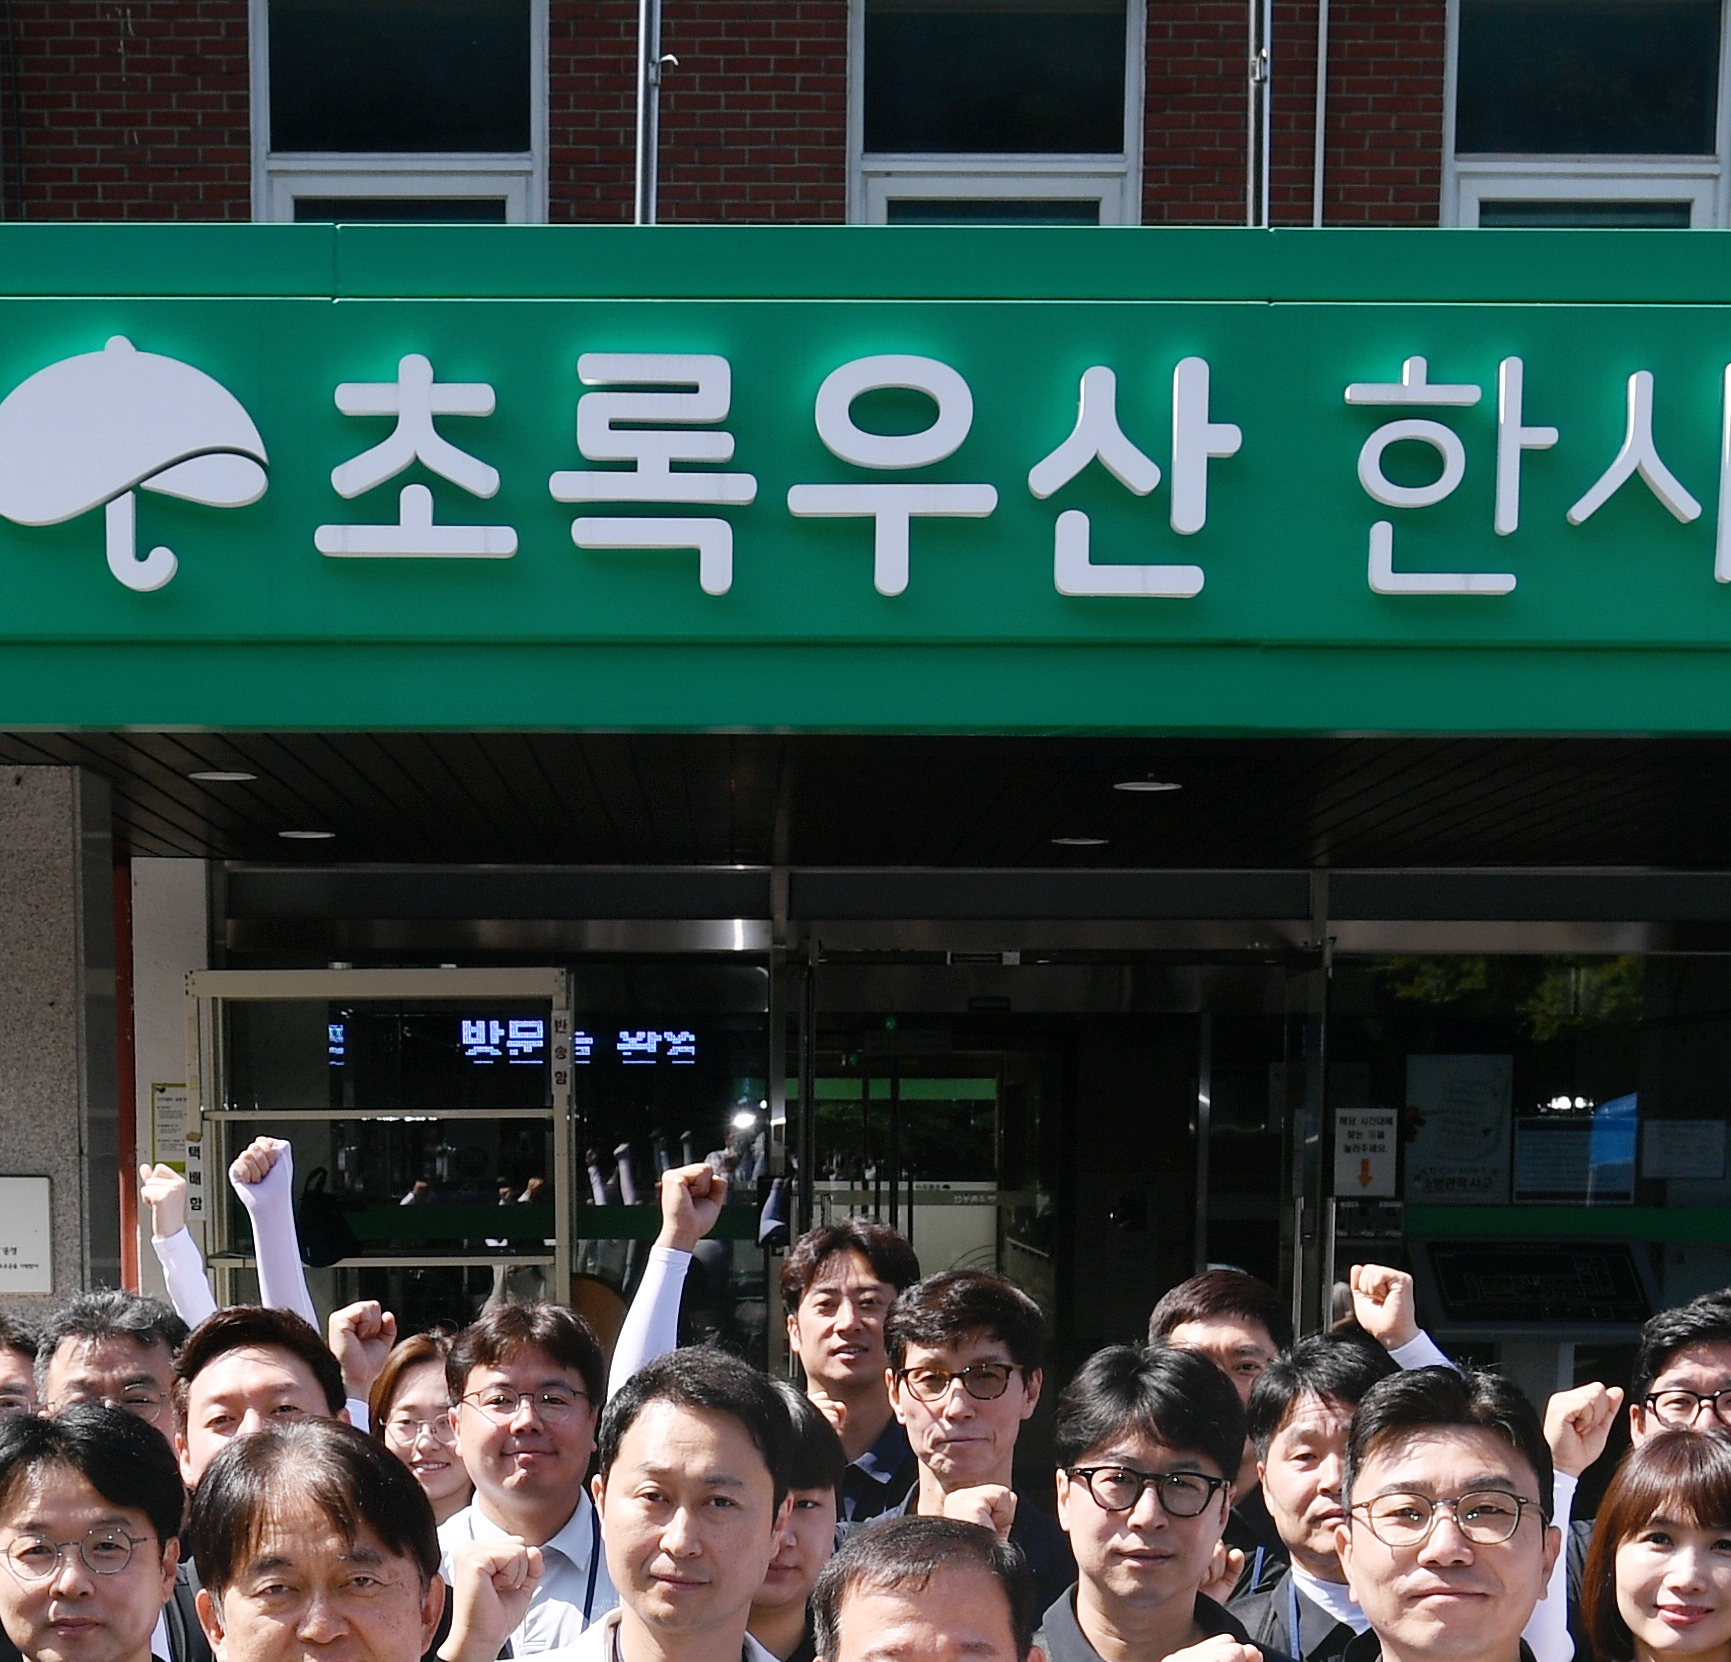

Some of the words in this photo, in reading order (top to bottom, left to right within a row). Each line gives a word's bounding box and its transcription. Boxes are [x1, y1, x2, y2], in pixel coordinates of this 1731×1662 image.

[314, 352, 1243, 597] 초록우산
[554, 1018, 567, 1085] 반송함
[188, 1145, 202, 1210] 택배함
